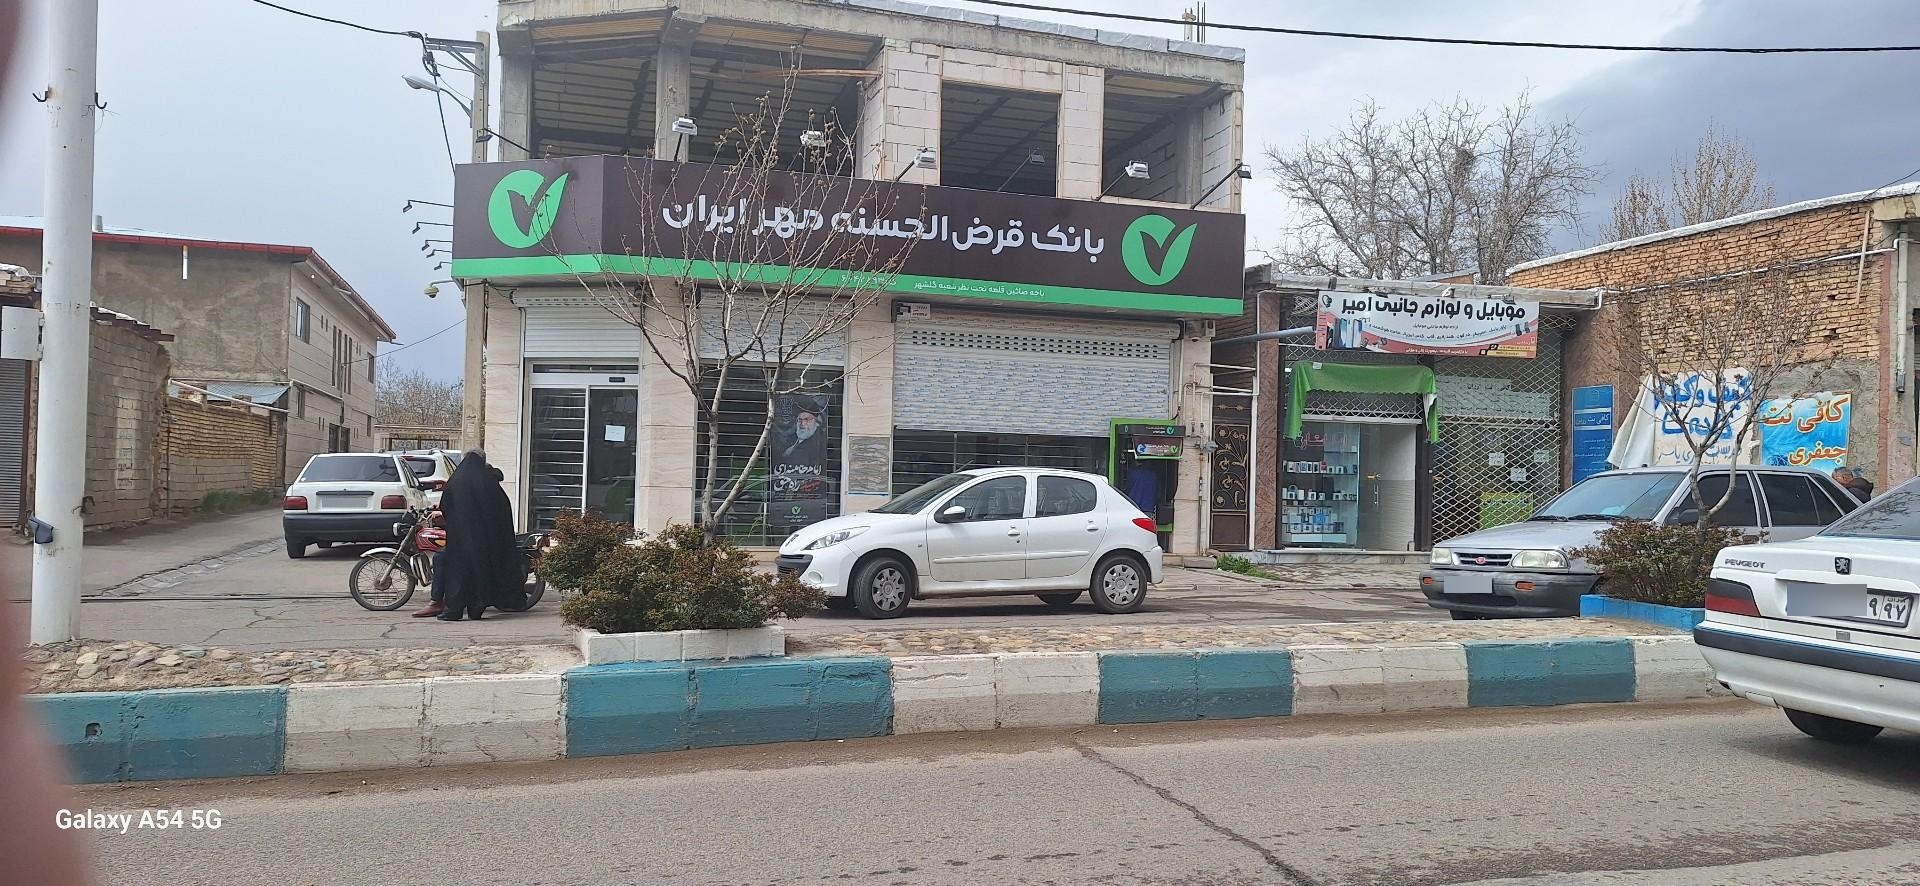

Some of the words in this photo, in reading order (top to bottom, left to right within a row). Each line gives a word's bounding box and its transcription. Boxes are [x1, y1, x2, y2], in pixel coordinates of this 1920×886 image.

[662, 194, 748, 234] ایران
[752, 207, 824, 240] مهر
[831, 207, 949, 243] الحسنه
[952, 215, 1024, 255] قرض
[1031, 222, 1105, 264] بانک
[913, 279, 938, 290] گلشهر
[1341, 296, 1372, 316] امیر
[1375, 297, 1419, 319] جانبی
[1421, 298, 1461, 319] لوازم
[1463, 303, 1473, 320] و
[1476, 302, 1526, 322] موبایل
[1762, 404, 1793, 427] نت
[1796, 397, 1850, 434] کافی
[1787, 444, 1848, 466] جعفری
[1724, 558, 1766, 569] PEUGEOT
